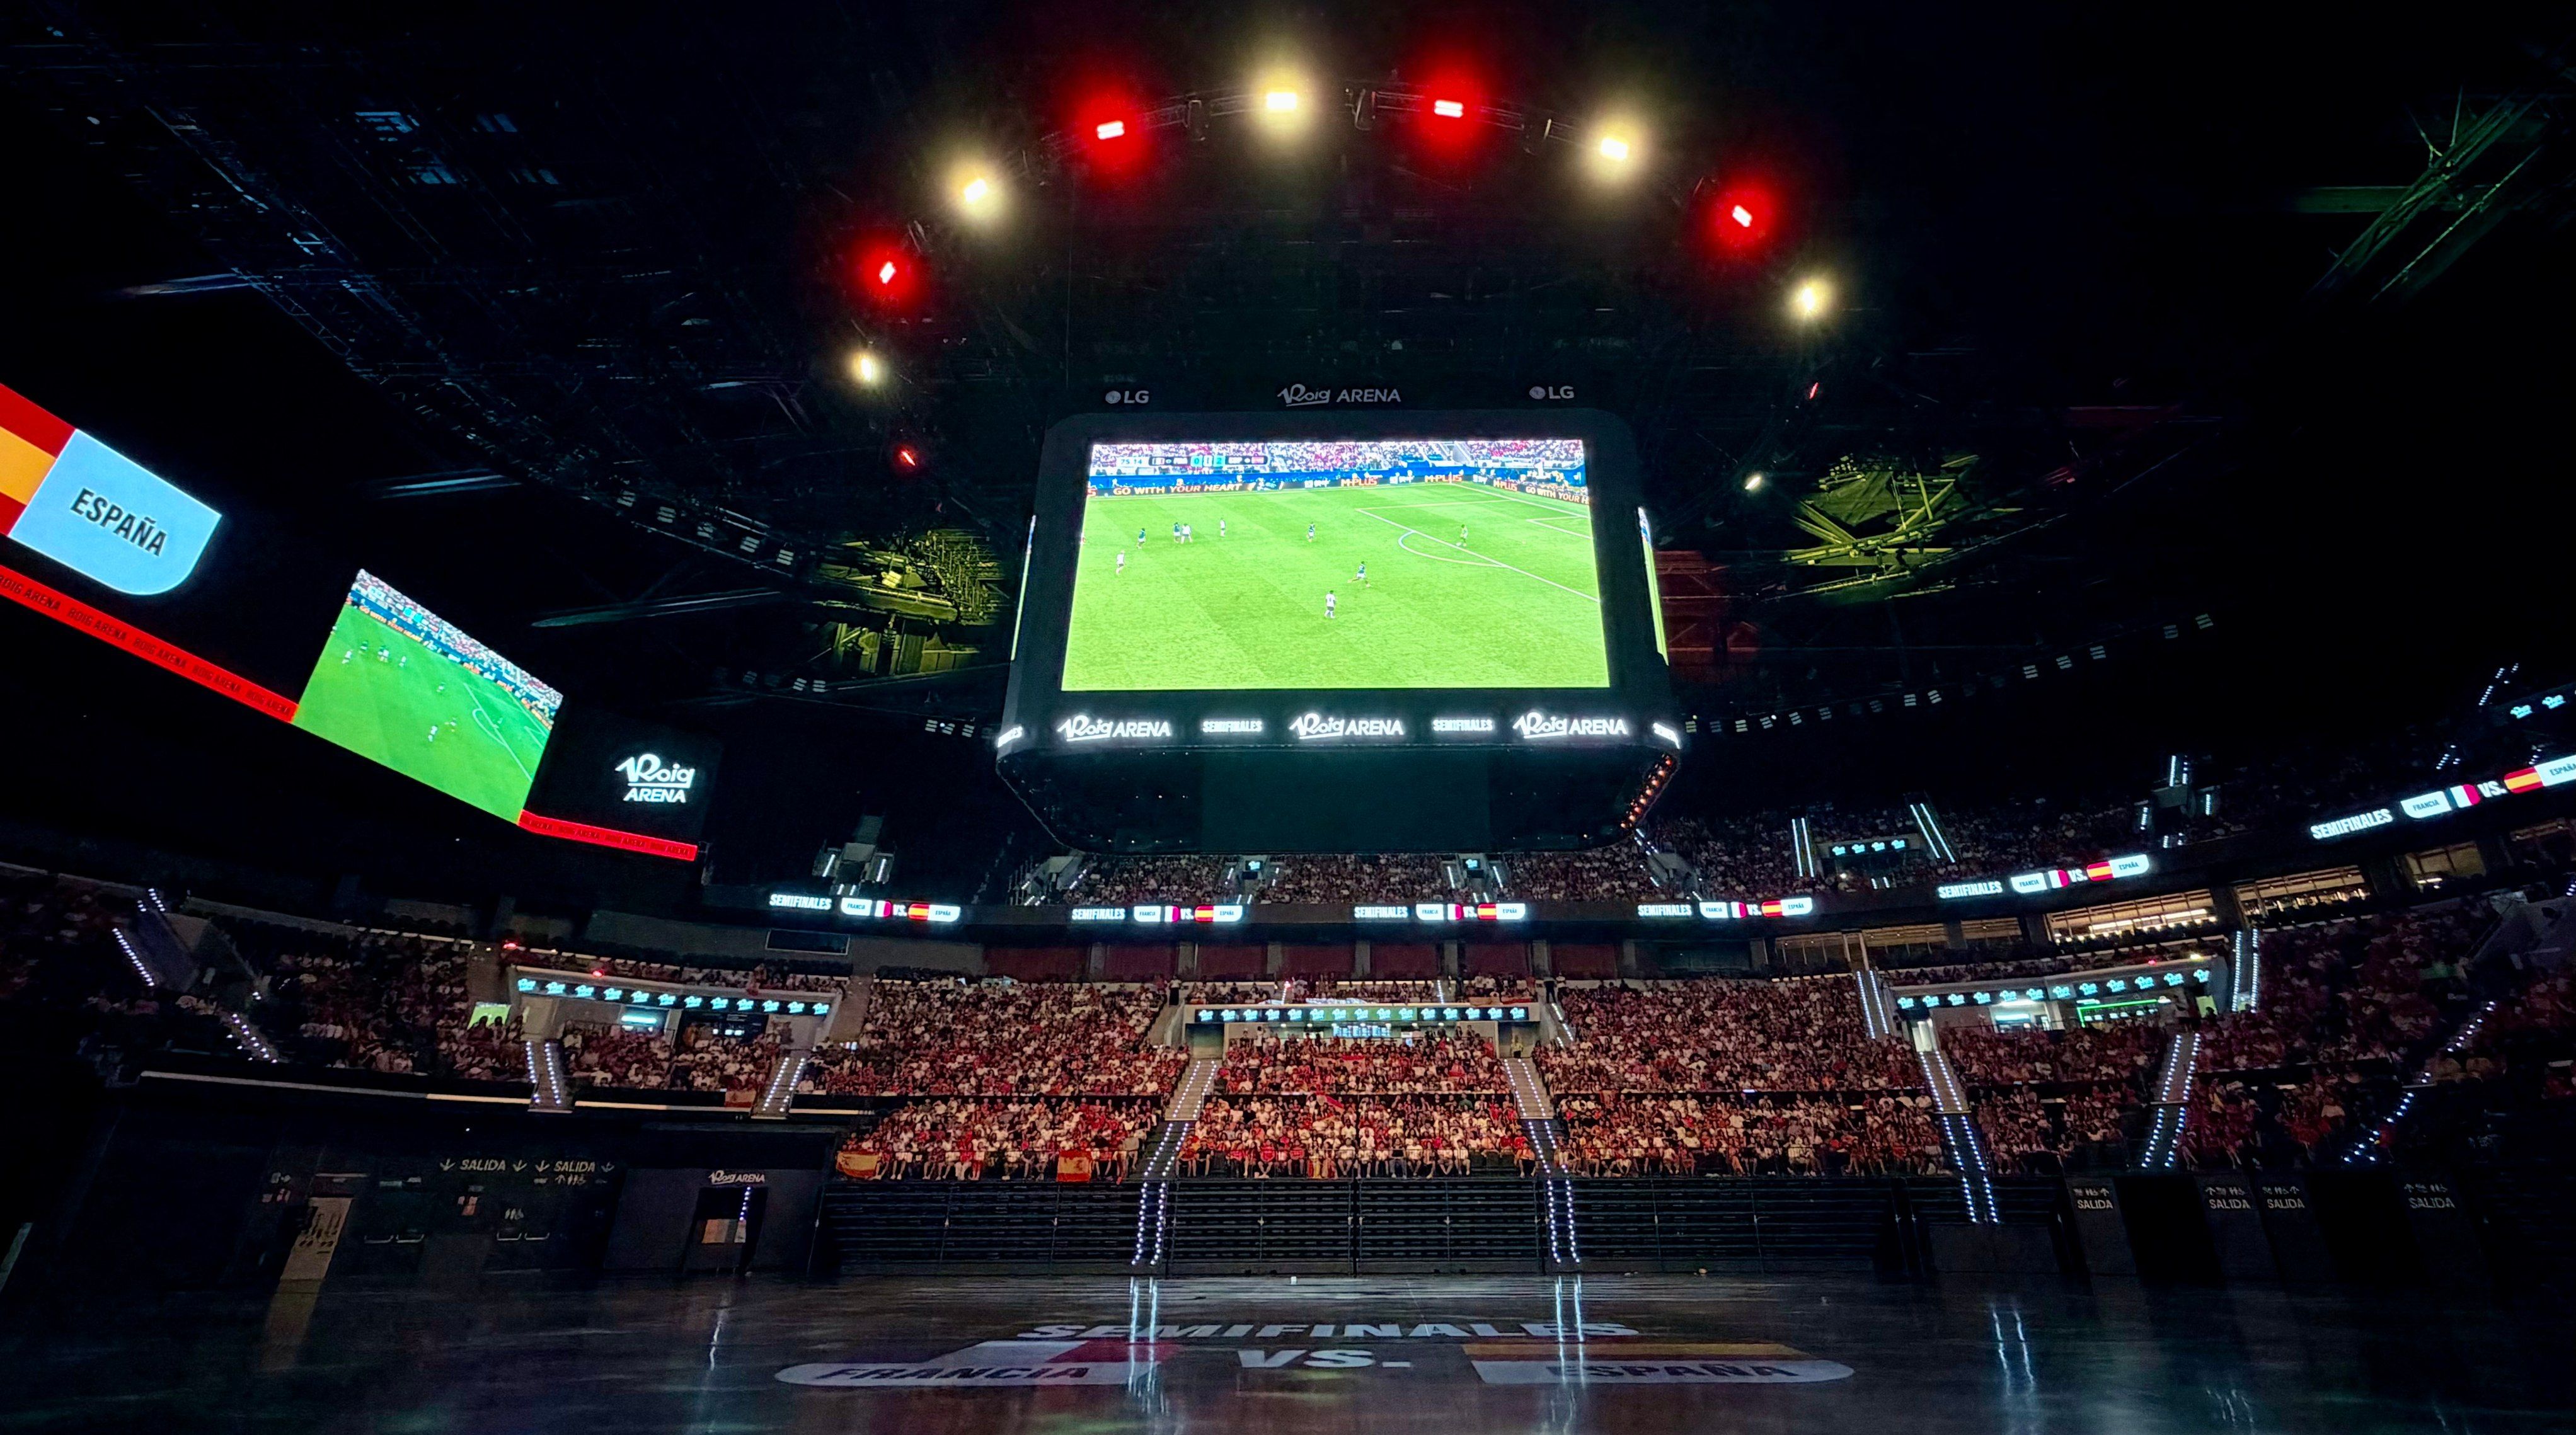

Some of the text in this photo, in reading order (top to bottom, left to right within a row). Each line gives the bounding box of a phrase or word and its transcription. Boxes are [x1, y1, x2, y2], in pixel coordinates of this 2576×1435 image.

[1124, 391, 1149, 403] LG
[1277, 384, 1401, 406] Roig ARENA
[1549, 386, 1574, 399] LG
[1113, 483, 1243, 496] GO WITH YOUR HEART
[1526, 486, 1536, 495] GO
[1538, 488, 1556, 498] WITH
[1558, 492, 1580, 503] YOUR
[70, 488, 168, 556] ESPAÑA
[1057, 715, 1171, 741] Roig ARENA
[1203, 721, 1262, 732] SEMIFINALES
[1289, 712, 1404, 740] Roig ARENA
[1433, 719, 1493, 731] SEMIFINALES
[1513, 712, 1628, 739] Roig ARENA
[615, 754, 695, 789] Roig
[2477, 780, 2509, 797] VS.
[623, 788, 686, 803] ARENA
[2413, 799, 2440, 811] FRANCIA
[2311, 809, 2393, 838] SEMIFINALES
[2069, 869, 2088, 882] VS.
[1938, 881, 2003, 898] SEMIFINALES
[769, 894, 832, 910] SEMIFINALES
[894, 904, 907, 916] VS.
[1072, 908, 1125, 920] SEMIFINALES
[1180, 908, 1194, 919] VS.
[1355, 906, 1408, 918] SEMIFINALES
[1463, 906, 1477, 917] VS.
[1638, 905, 1692, 916] SEMIFINALES
[1747, 903, 1762, 915] VS.
[460, 1160, 505, 1170] SALIDA
[554, 1161, 595, 1172] SALIDA
[2078, 1200, 2113, 1208] SALIDA
[2209, 1199, 2250, 1209] SALIDA
[2267, 1199, 2304, 1208] SALIDA
[2409, 1198, 2454, 1208] SALIDA
[1016, 1323, 1639, 1338] SEMIFINALES
[1237, 1349, 1412, 1368] VS.
[815, 1367, 1089, 1380] FRANCIA
[1548, 1363, 1800, 1378] ESPAÑA
